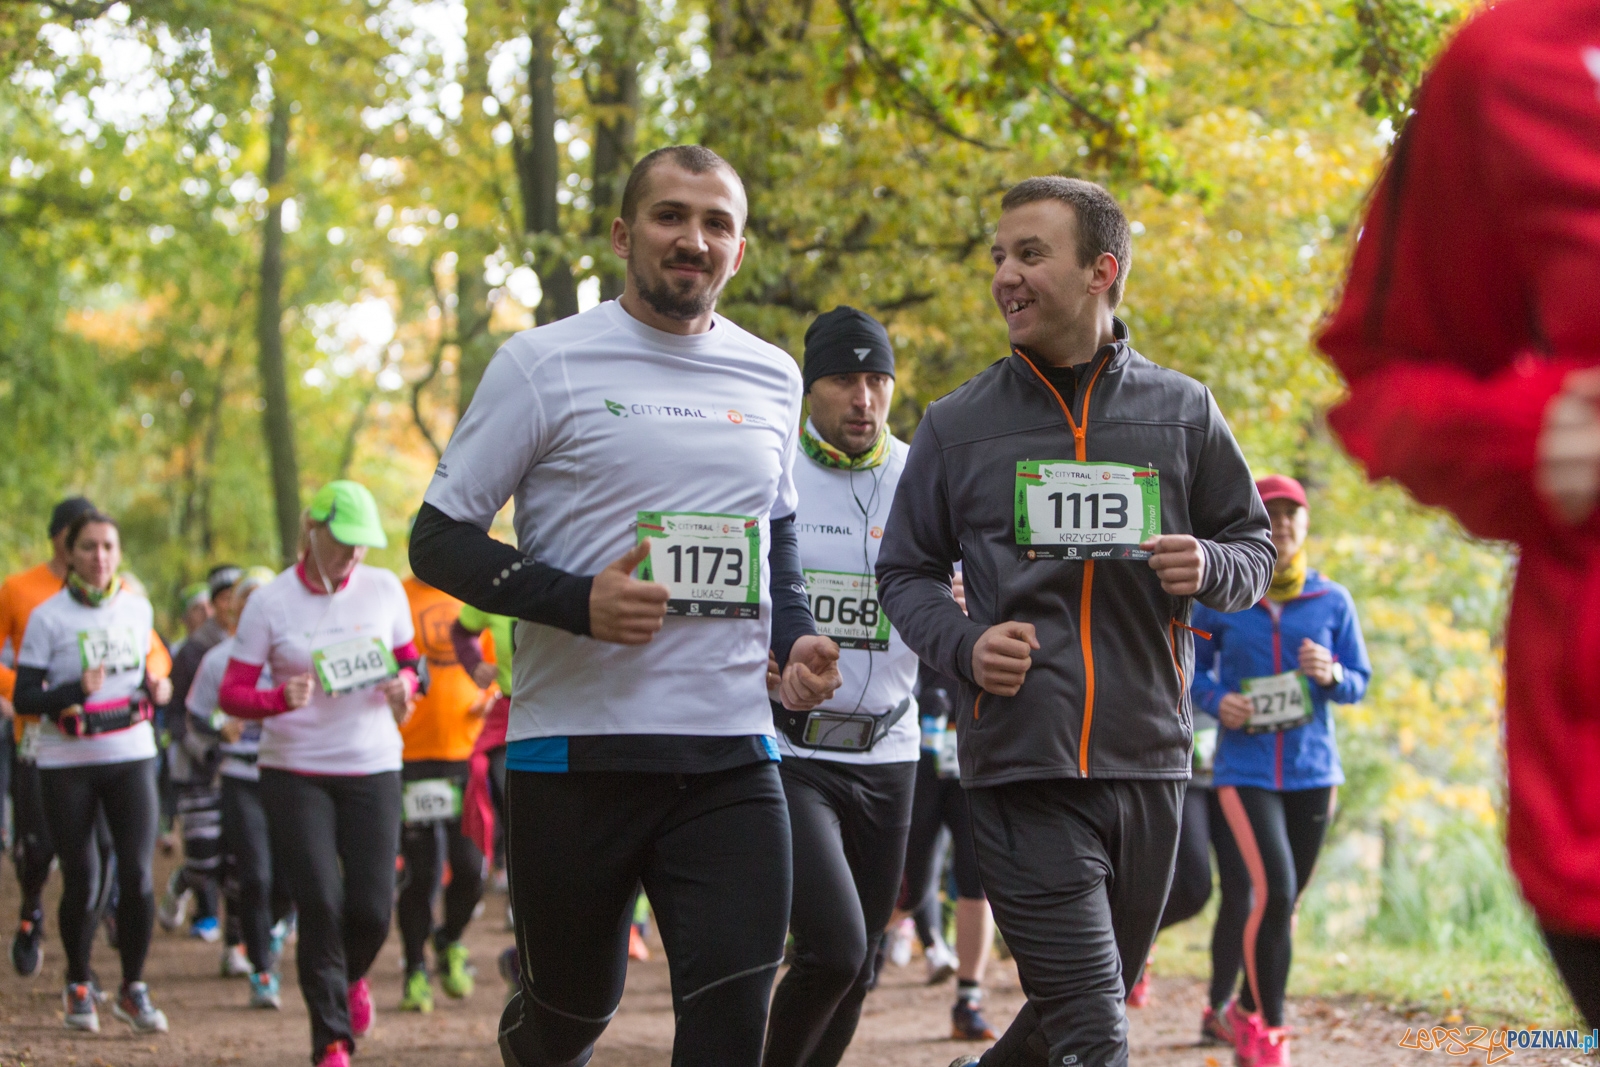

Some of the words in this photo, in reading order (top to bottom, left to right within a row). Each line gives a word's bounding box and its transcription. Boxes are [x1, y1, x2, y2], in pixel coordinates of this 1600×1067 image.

[1048, 492, 1129, 529] 1113
[1059, 533, 1117, 543] KRZYSZTOF
[667, 545, 743, 586] 1173
[692, 589, 724, 599] ŁUKASZ
[330, 650, 383, 680] 1348
[1252, 689, 1302, 714] 1274
